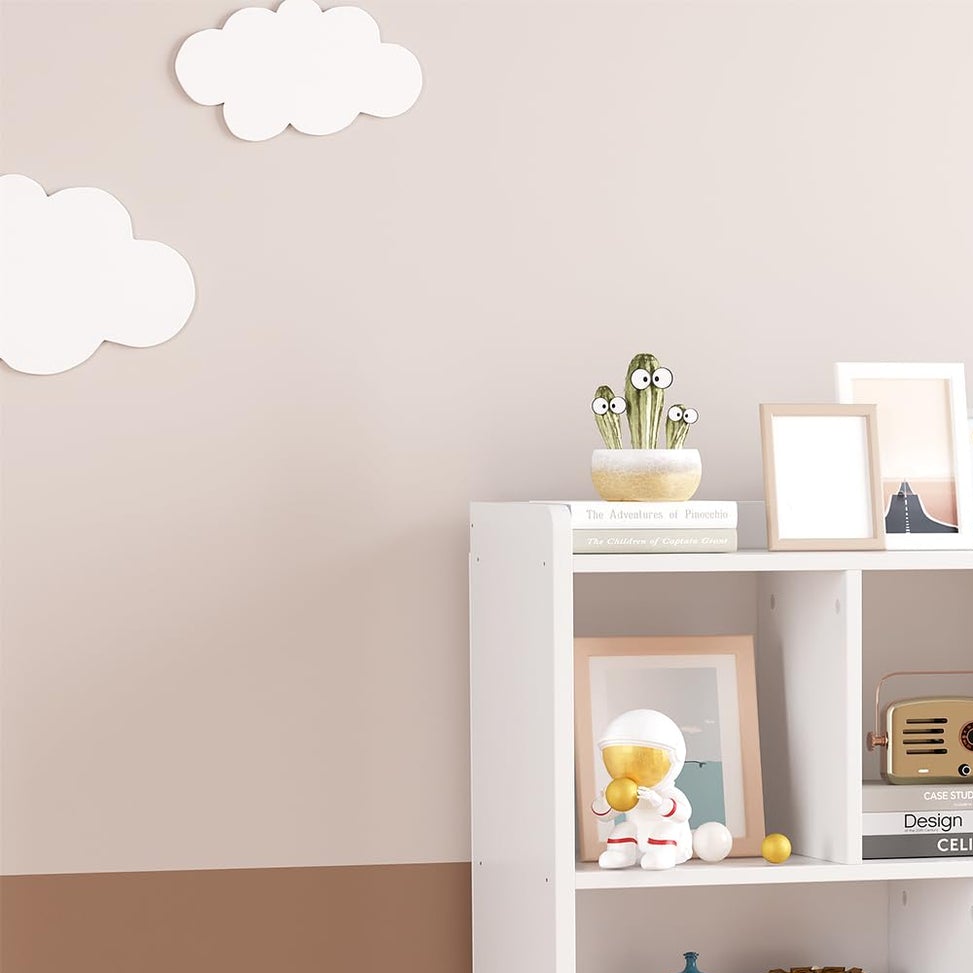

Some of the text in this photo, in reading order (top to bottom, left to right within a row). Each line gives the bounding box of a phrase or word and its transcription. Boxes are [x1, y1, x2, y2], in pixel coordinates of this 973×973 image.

[586, 509, 604, 520] The
[609, 508, 664, 520] Adventures
[685, 508, 729, 520] Pinocchio
[587, 537, 604, 545] The
[607, 537, 646, 545] Children
[923, 790, 949, 800] CASE
[904, 812, 963, 832] Design
